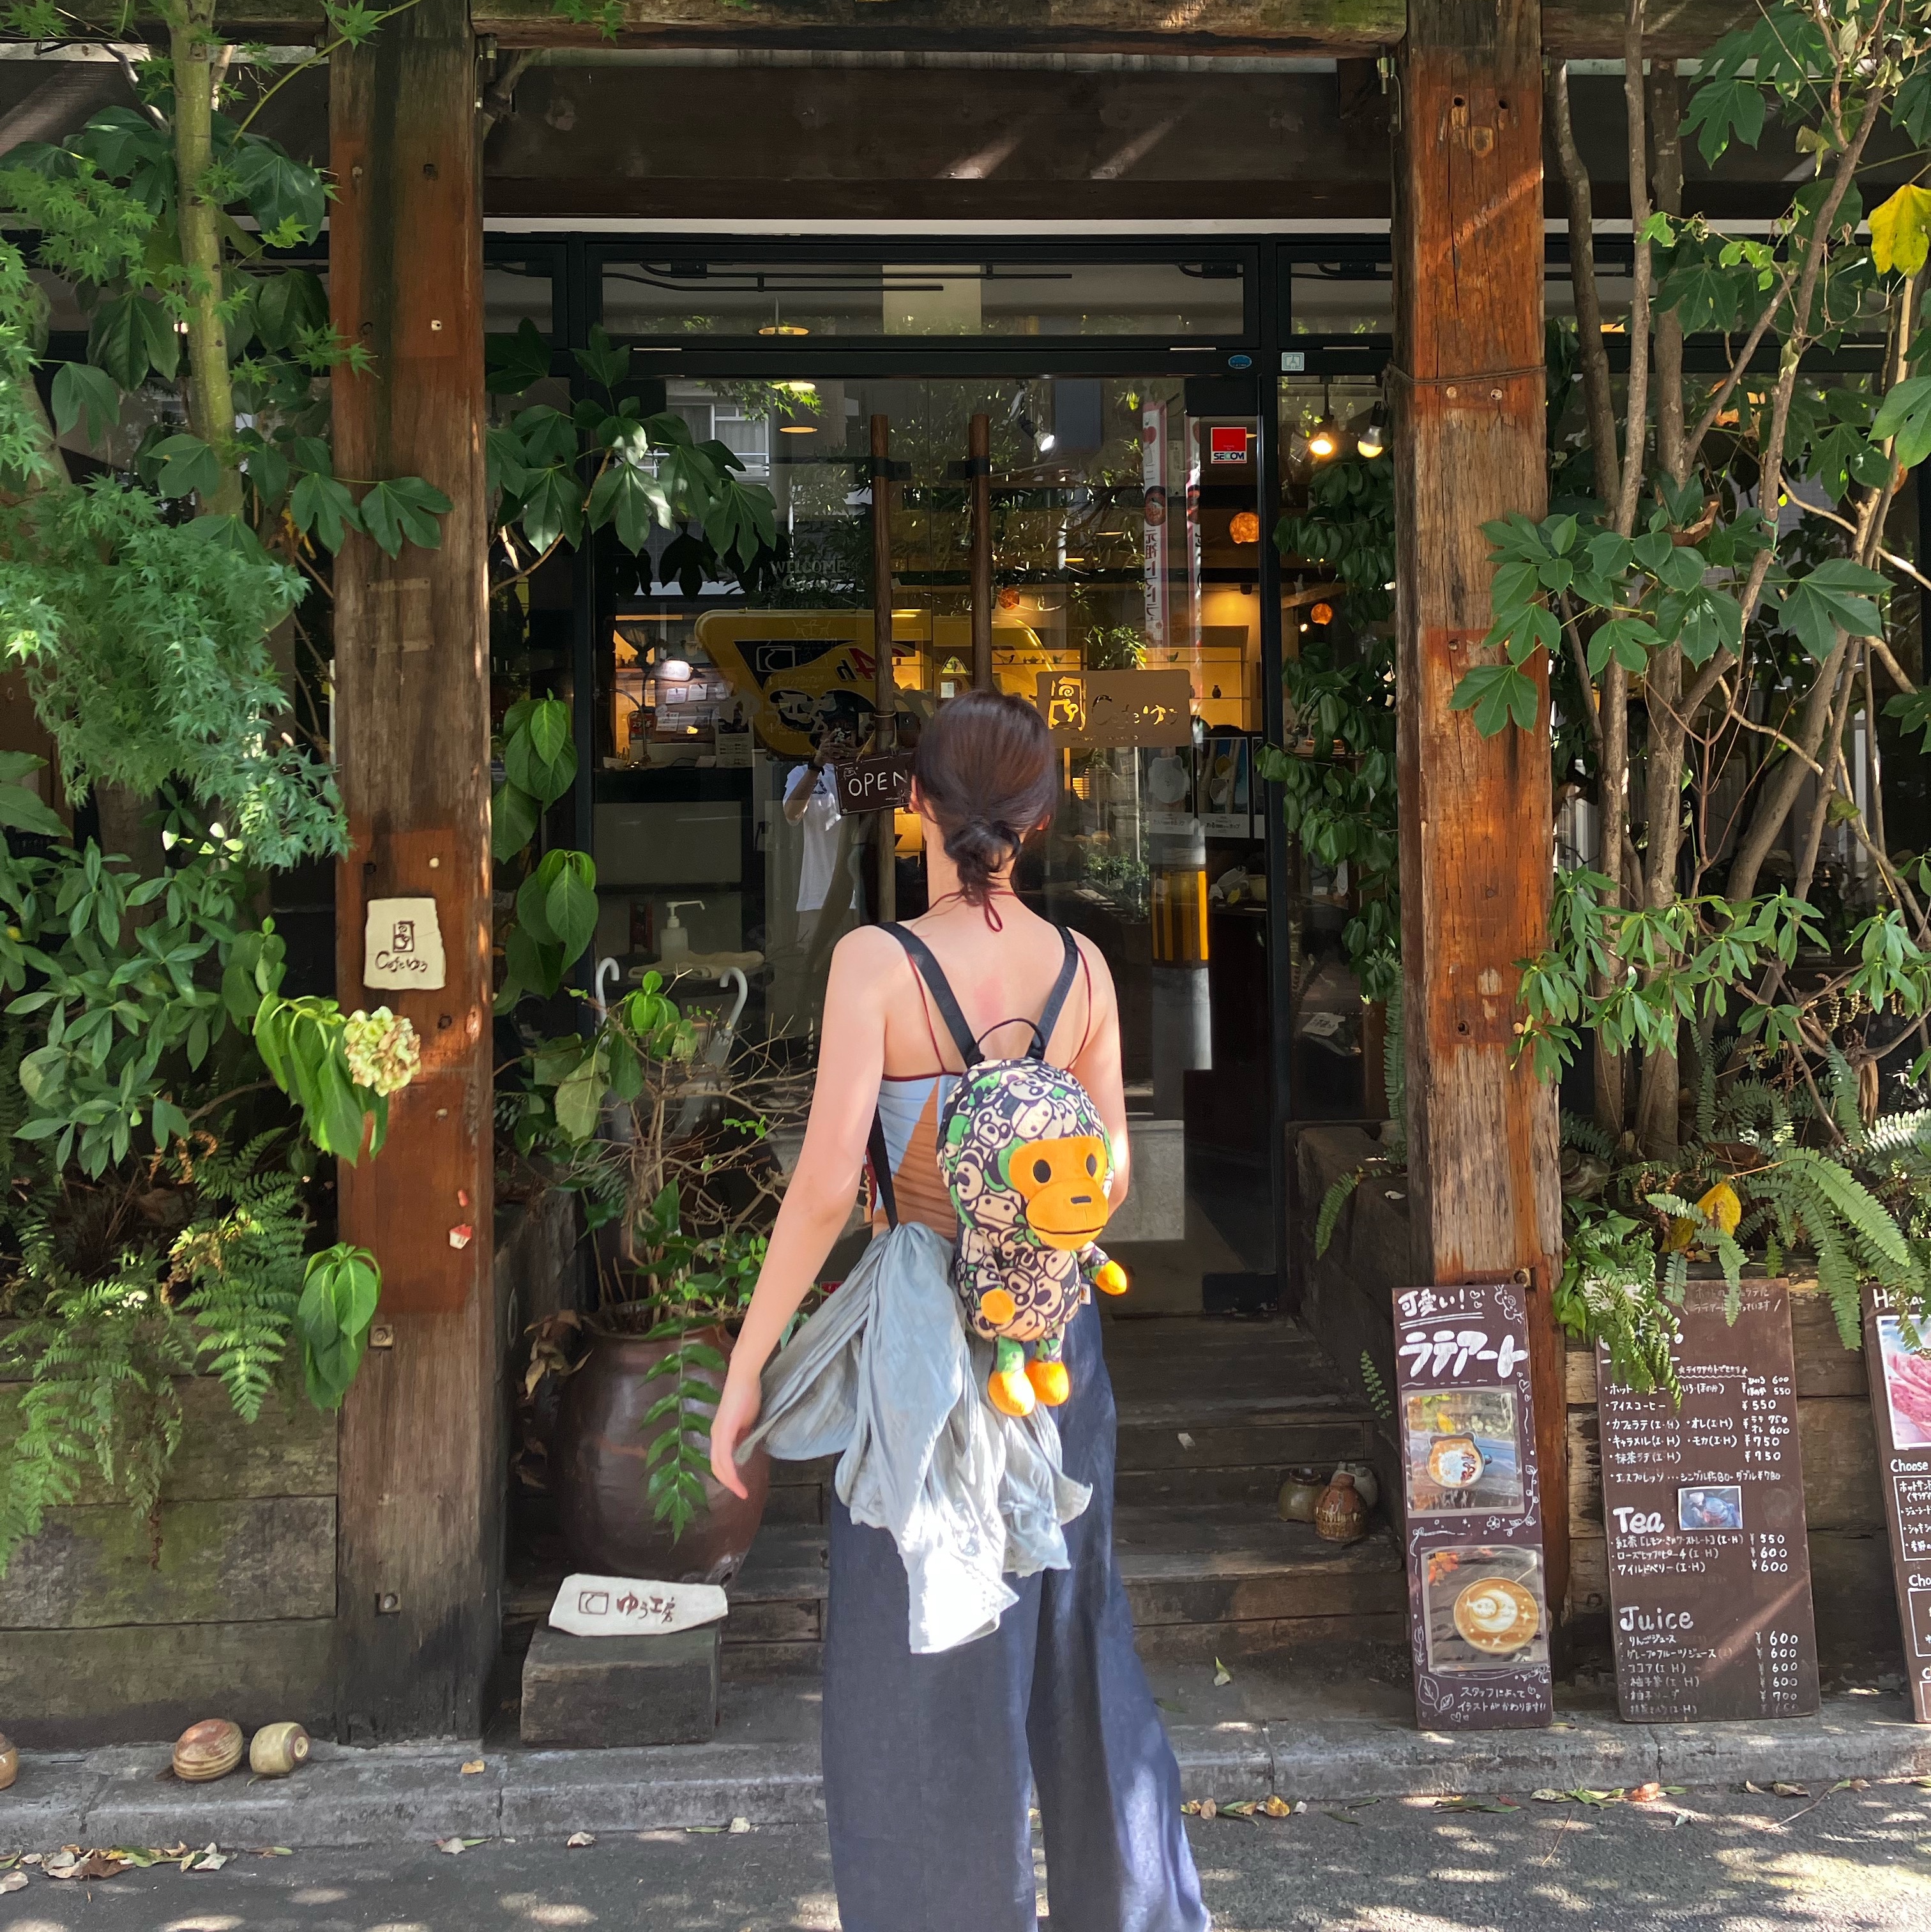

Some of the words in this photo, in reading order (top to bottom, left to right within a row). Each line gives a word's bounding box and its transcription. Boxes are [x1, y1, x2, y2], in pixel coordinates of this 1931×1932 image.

[769, 559, 847, 574] WELCOME
[848, 769, 908, 797] OPEN
[1398, 1330, 1528, 1378] ラテアート
[1772, 1375, 1789, 1384] 600
[1773, 1387, 1791, 1396] 550
[1610, 1401, 1666, 1411] アイスコーヒー
[1768, 1415, 1789, 1424] 750
[1769, 1425, 1790, 1434] 600
[1890, 1459, 1928, 1472] Choose
[1612, 1506, 1665, 1533] Tea
[1619, 1606, 1694, 1631] Juice
[1460, 1687, 1526, 1699] スタッフによって
